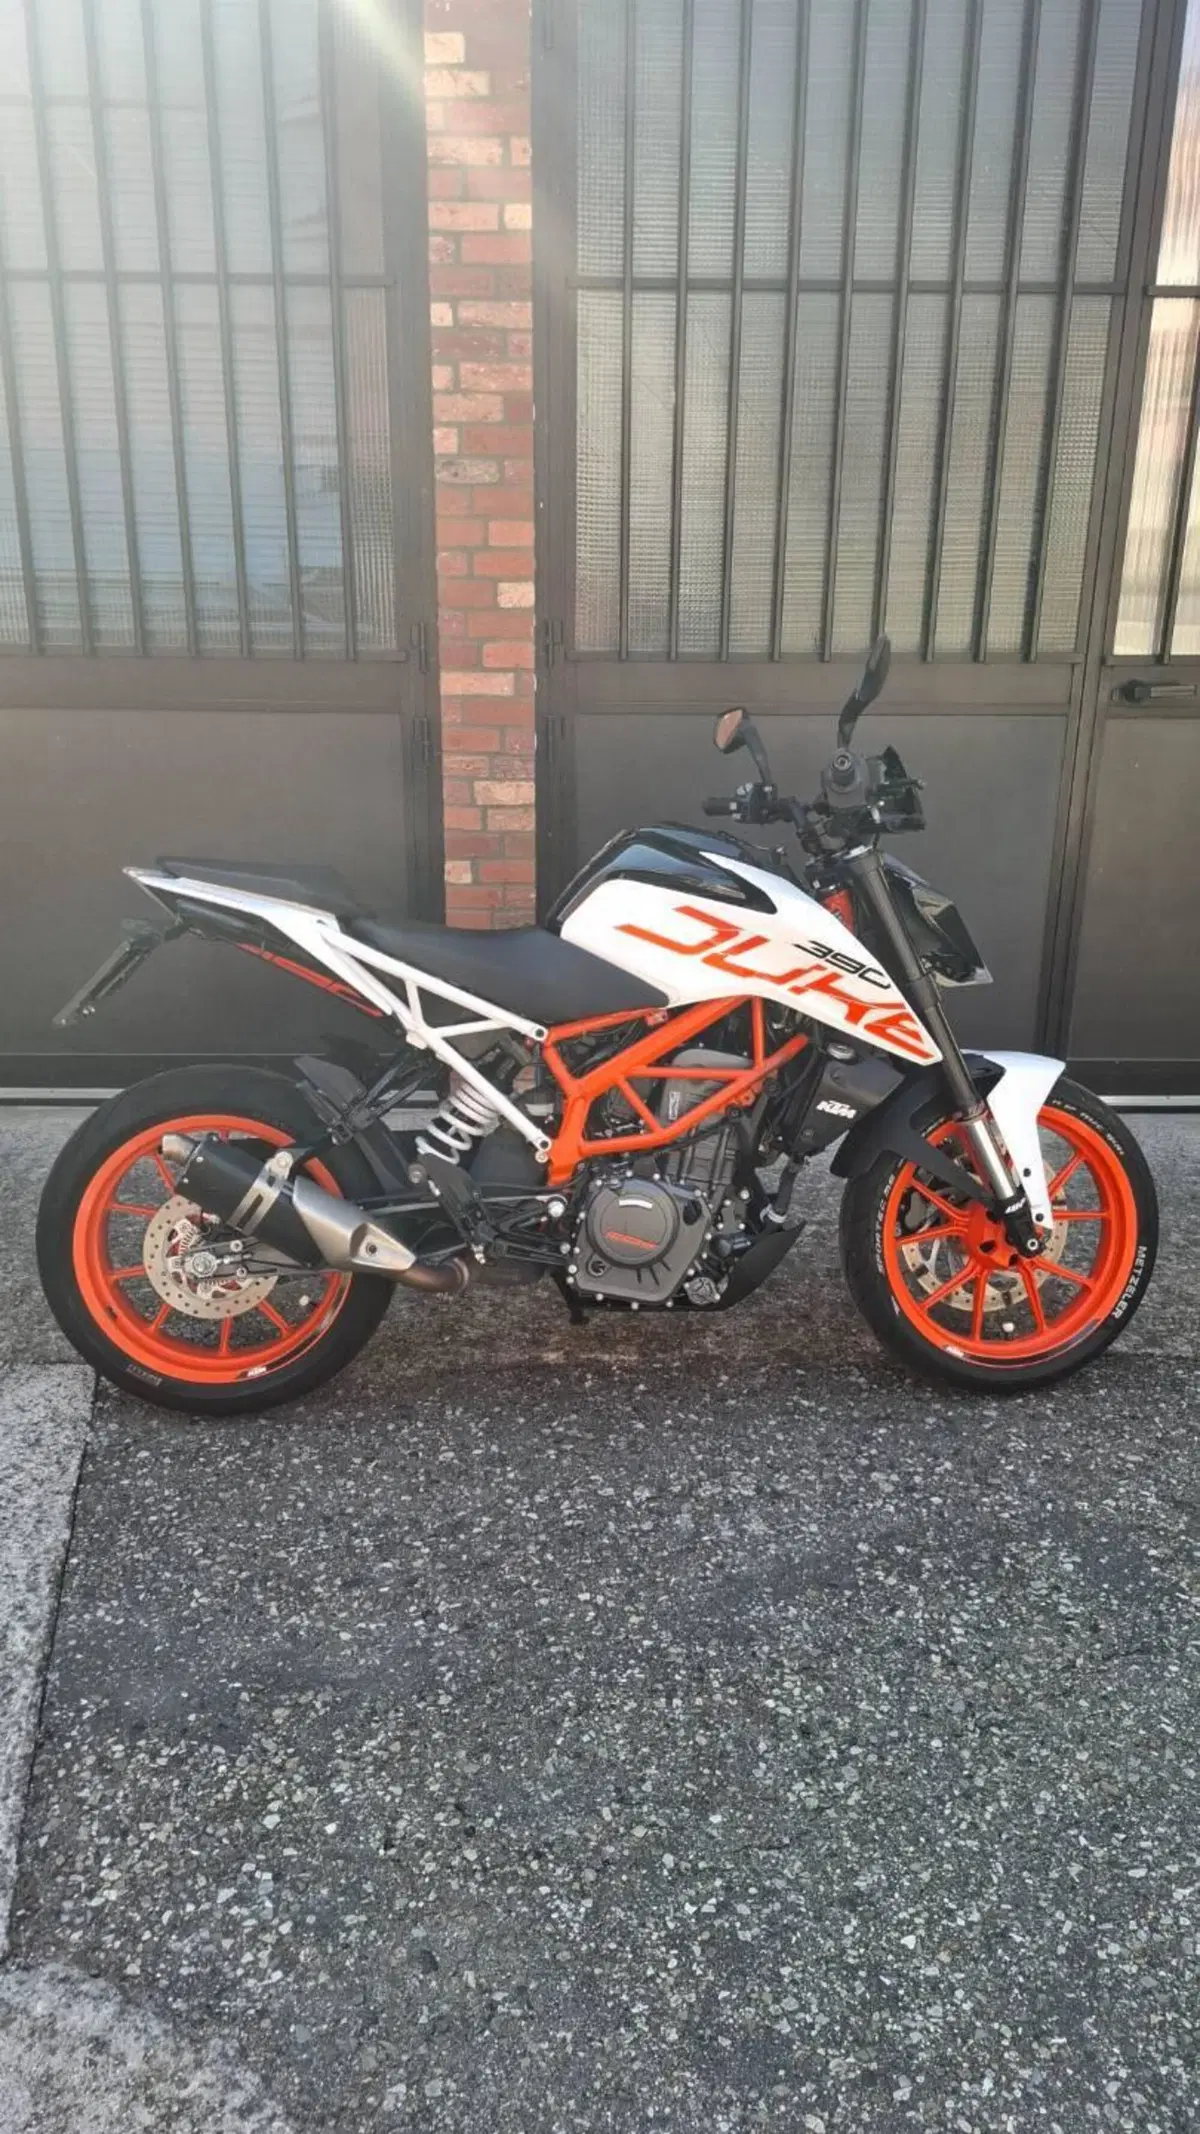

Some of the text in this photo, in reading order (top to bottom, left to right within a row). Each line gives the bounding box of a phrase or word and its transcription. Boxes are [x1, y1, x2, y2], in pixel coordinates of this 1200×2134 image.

[613, 904, 934, 1060] DUKE
[791, 940, 891, 990] 390
[816, 1100, 857, 1119] KTM
[1111, 1245, 1148, 1319] METZELER
